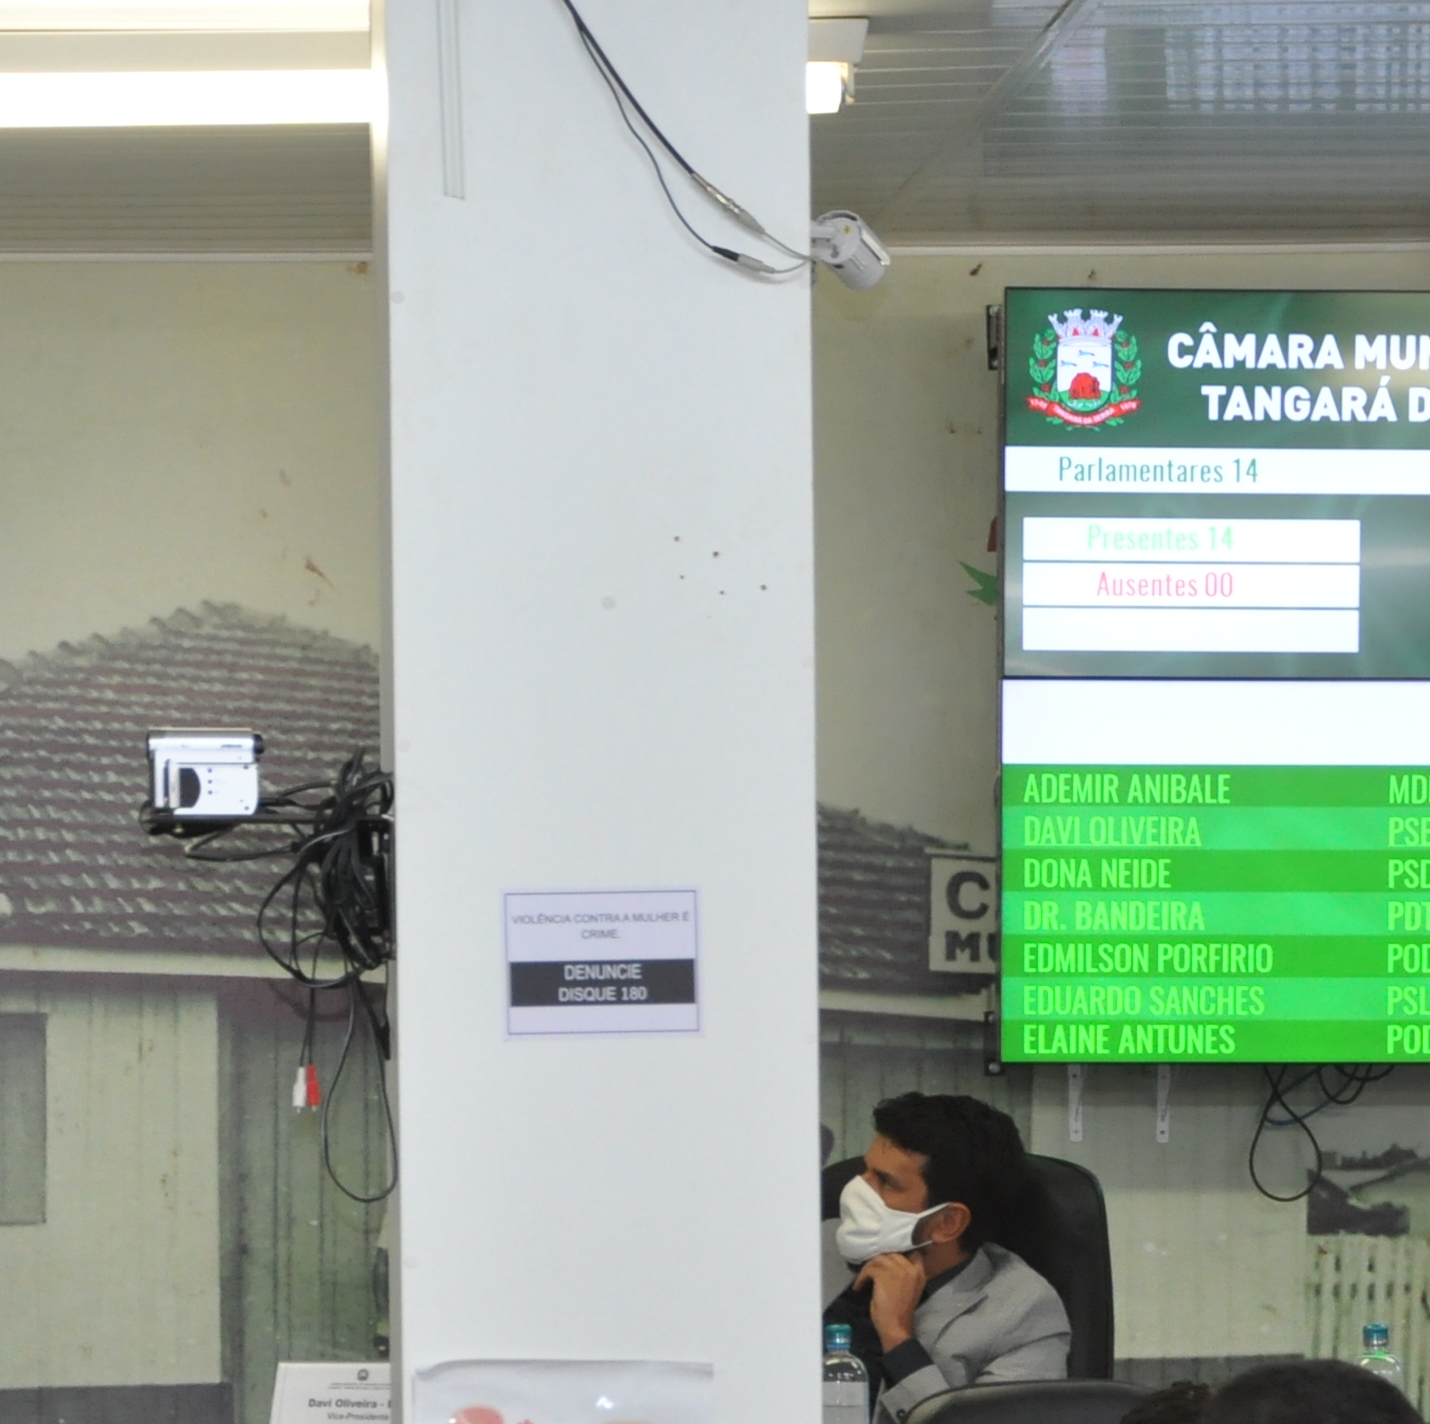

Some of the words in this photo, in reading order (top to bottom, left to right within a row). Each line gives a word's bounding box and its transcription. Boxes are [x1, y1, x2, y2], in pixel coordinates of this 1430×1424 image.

[1167, 321, 1344, 370] CÂMARA
[1201, 375, 1398, 423] TANGARÁ
[1058, 455, 1224, 484] Parlamentares
[1233, 458, 1259, 484] 14
[1086, 524, 1199, 552] Presentes
[1207, 526, 1234, 552] 14
[1096, 571, 1199, 598] Ausentes
[1204, 571, 1234, 598] 00
[1022, 773, 1120, 804] ADEMIR
[1127, 774, 1232, 804] ANIBALE
[1023, 815, 1080, 847] DAVI
[1088, 816, 1203, 847] OLIVEIRA
[1023, 858, 1093, 889] DONA
[1101, 858, 1172, 889] NEIDE
[512, 911, 571, 925] VIOLÊNCIA
[573, 912, 621, 924] CONTRA
[632, 911, 679, 923] MULHER
[1023, 901, 1067, 931] DR.
[1076, 901, 1205, 932] BANDEIRA
[564, 963, 642, 981] DENUNCIE
[1022, 943, 1149, 975] EDMILSON
[1157, 944, 1274, 974] PORFIRIO
[558, 986, 617, 1002] DISQUE
[621, 986, 648, 1001] 180
[1022, 986, 1142, 1017] EDUARDO
[1149, 986, 1266, 1016] SANCHES
[1022, 1024, 1110, 1054] ELAINE
[1118, 1024, 1236, 1054] ANTUNES
[307, 1398, 332, 1408] Davi
[334, 1398, 378, 1409] Oliveira
